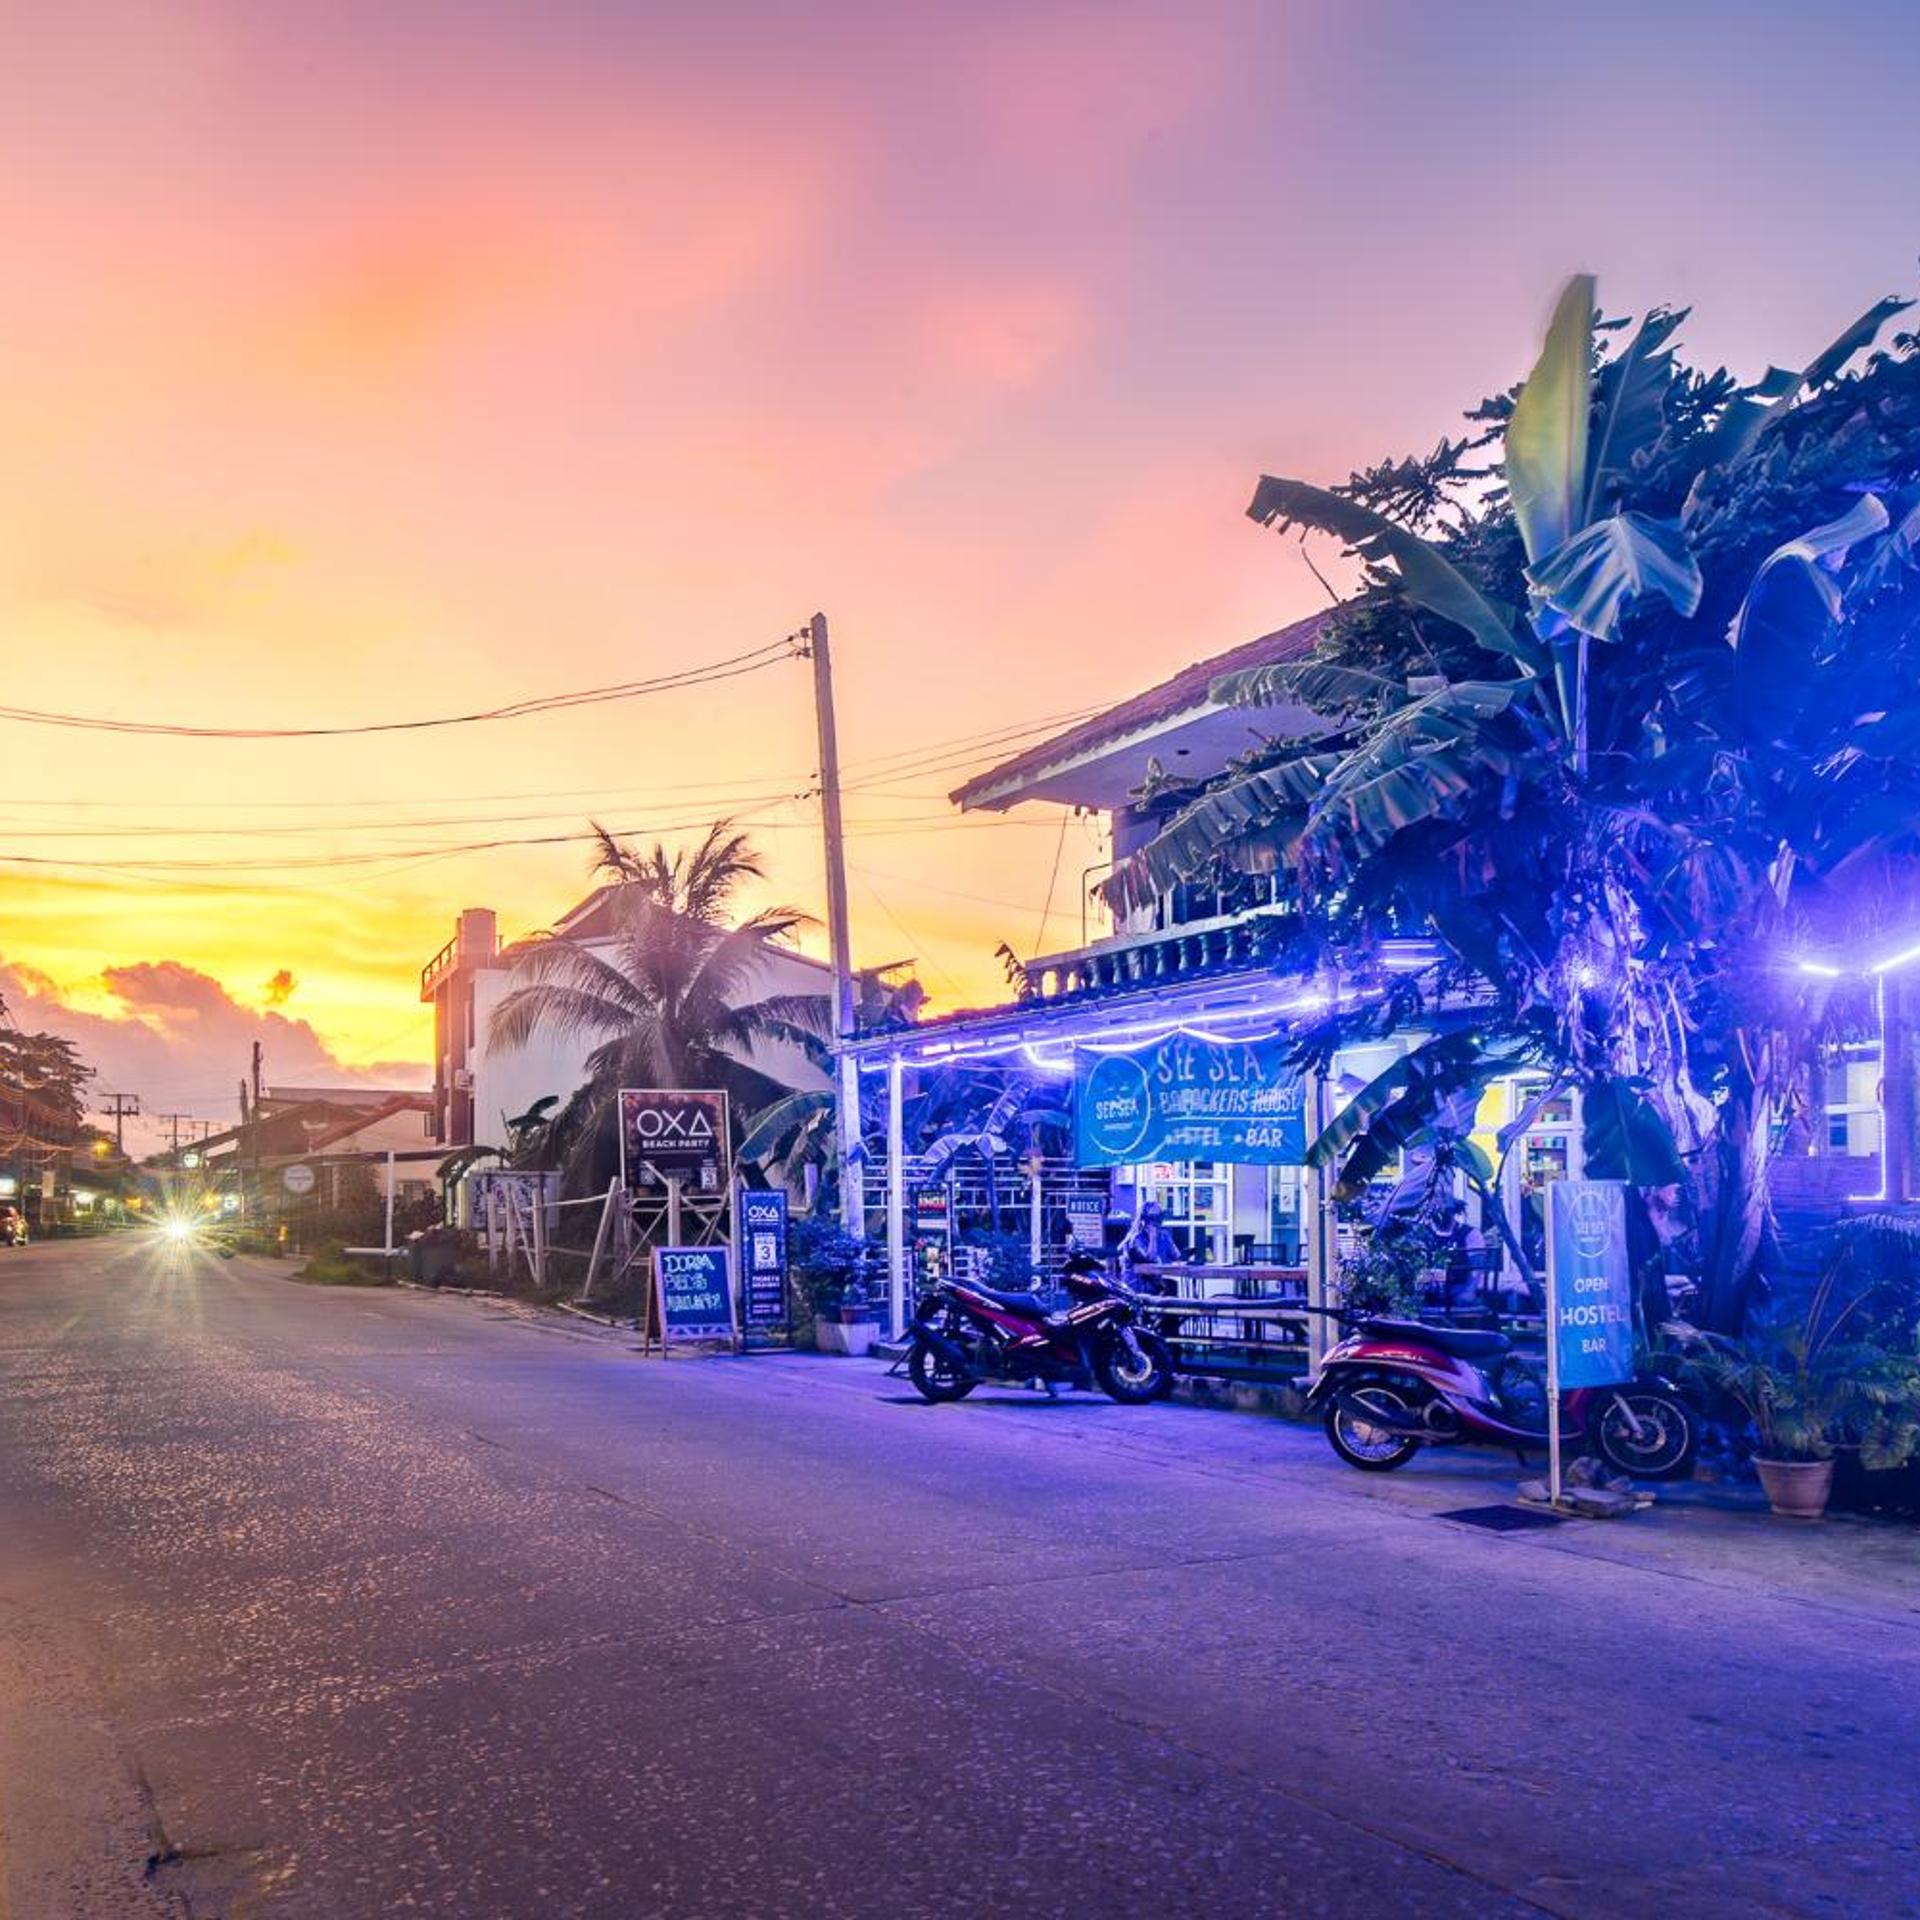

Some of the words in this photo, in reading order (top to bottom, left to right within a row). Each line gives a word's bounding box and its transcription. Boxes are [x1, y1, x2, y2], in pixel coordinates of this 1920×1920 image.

[1209, 1043, 1266, 1082] SEA
[678, 1139, 711, 1148] PARTY
[1245, 1128, 1284, 1147] BAR
[761, 1246, 771, 1260] 3
[1574, 1277, 1609, 1293] OPEN
[1560, 1305, 1625, 1327] HOSTEL
[1582, 1338, 1606, 1354] BAR
